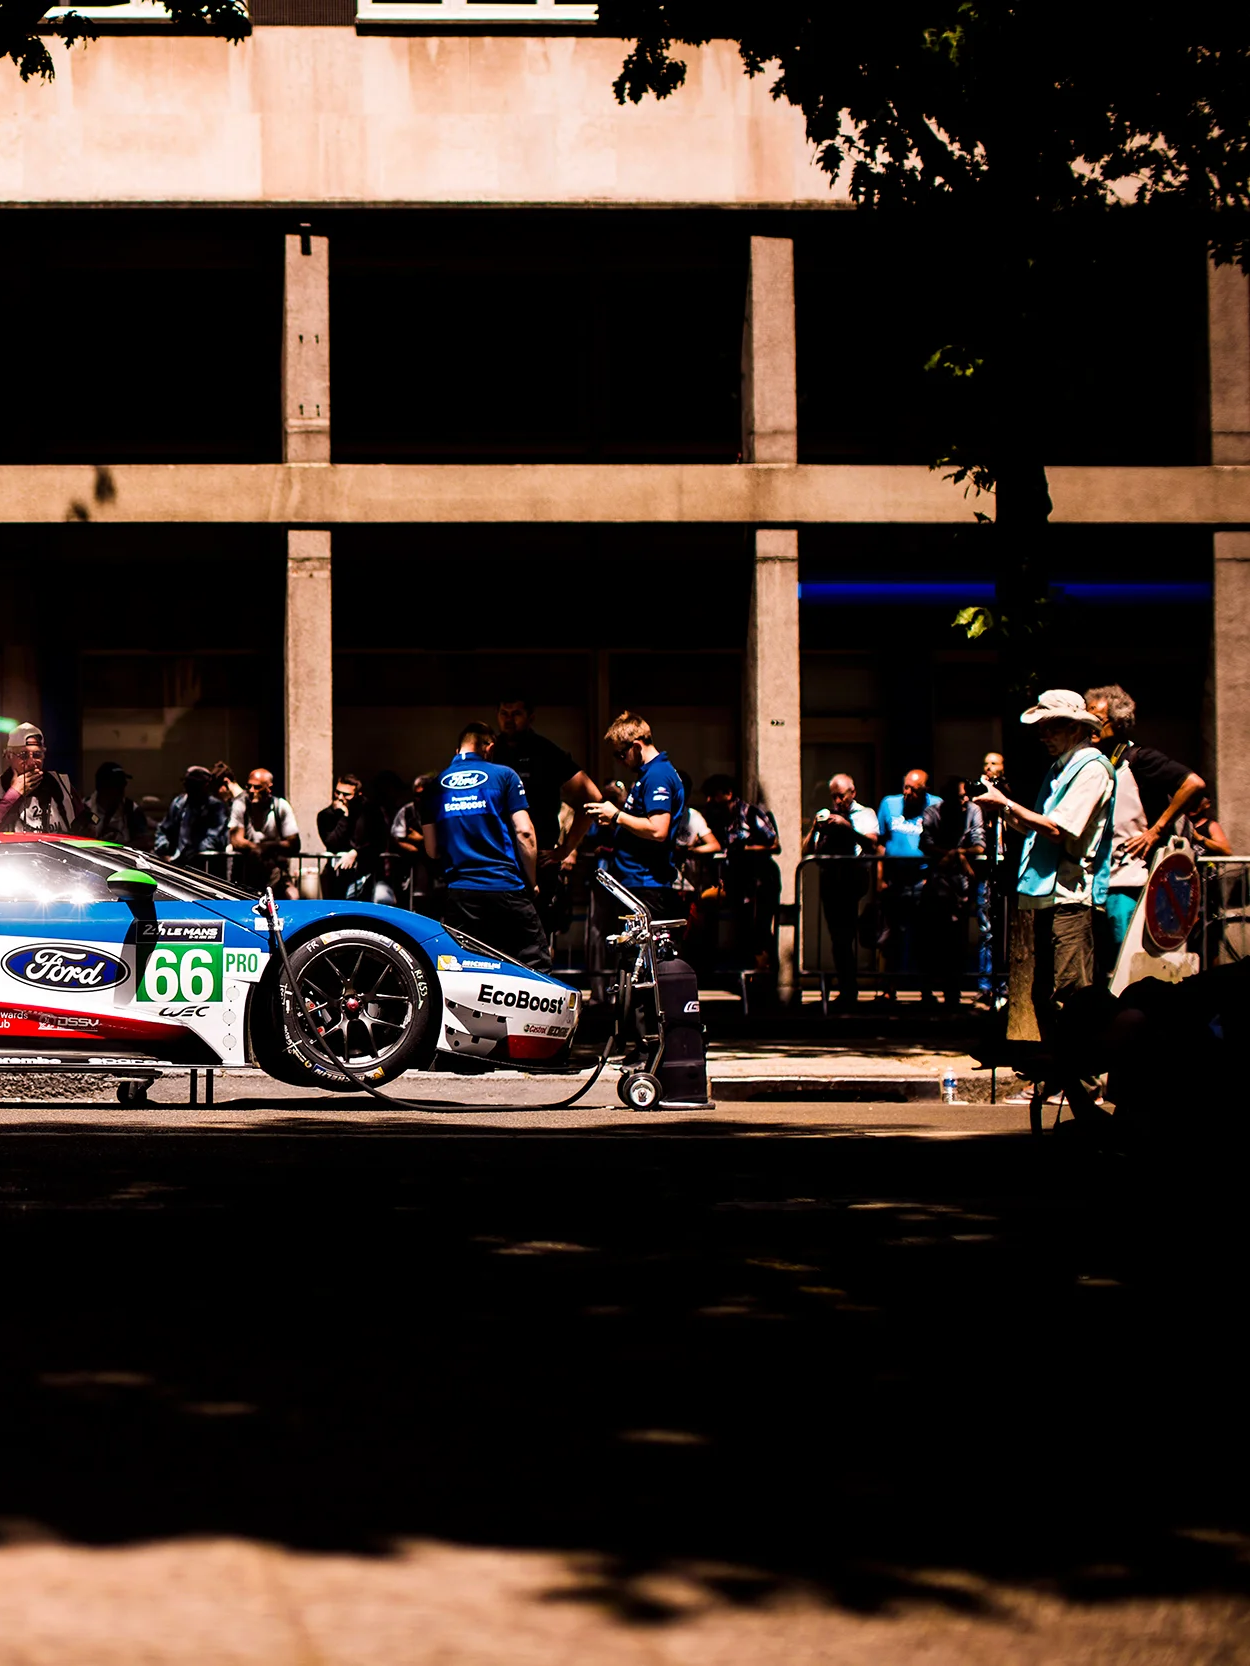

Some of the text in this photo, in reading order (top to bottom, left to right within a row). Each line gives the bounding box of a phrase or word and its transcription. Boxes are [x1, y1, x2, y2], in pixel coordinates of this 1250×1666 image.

[449, 773, 479, 787] Ford
[444, 800, 487, 811] EcoBoost
[166, 928, 182, 936] LE
[183, 928, 218, 936] MANS
[306, 941, 320, 954] FR
[25, 948, 105, 985] Ford
[226, 953, 258, 972] PRO
[144, 949, 215, 1002] 66
[477, 984, 566, 1014] EcoBoost
[159, 1006, 209, 1017] WEC
